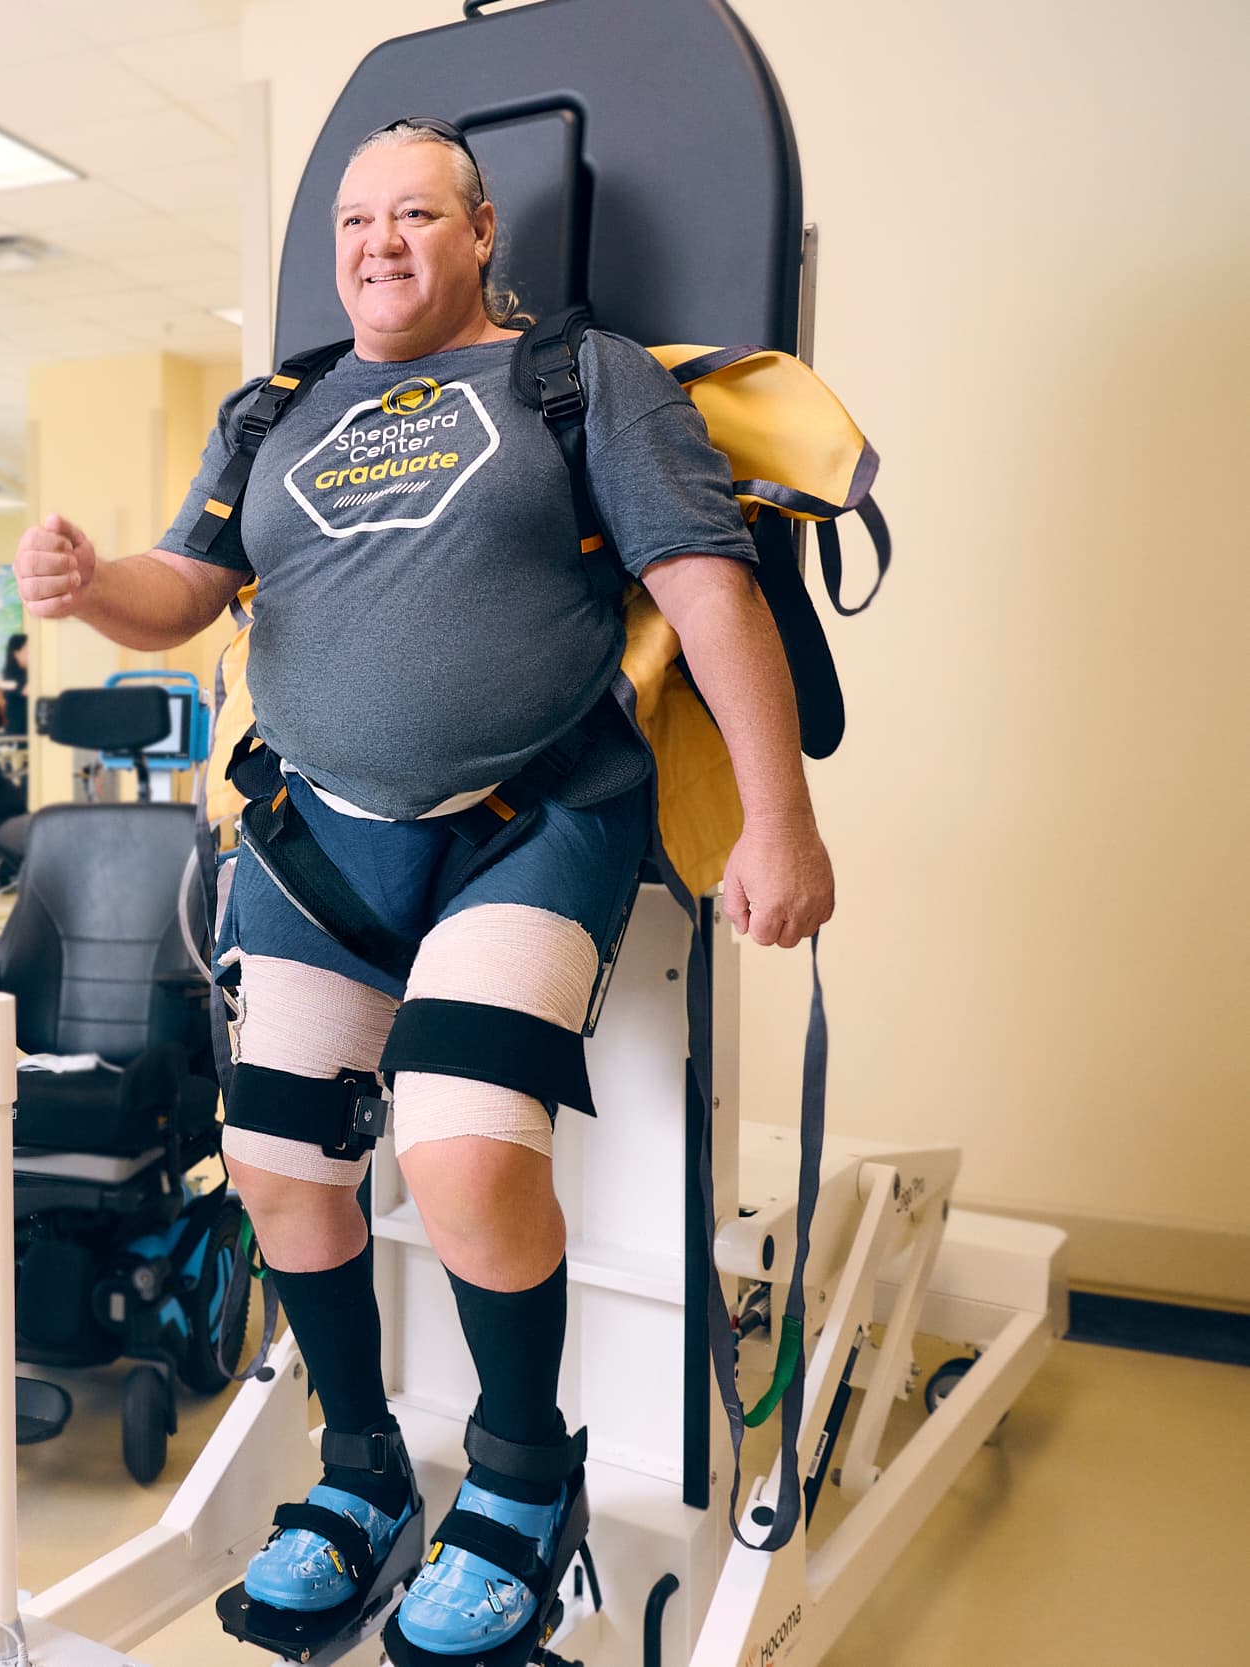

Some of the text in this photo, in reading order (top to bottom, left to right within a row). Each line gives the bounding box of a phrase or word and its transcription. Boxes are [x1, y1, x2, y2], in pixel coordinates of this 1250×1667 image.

[335, 411, 458, 451] Shepherd
[350, 434, 434, 463] Center
[315, 451, 459, 490] Graduate
